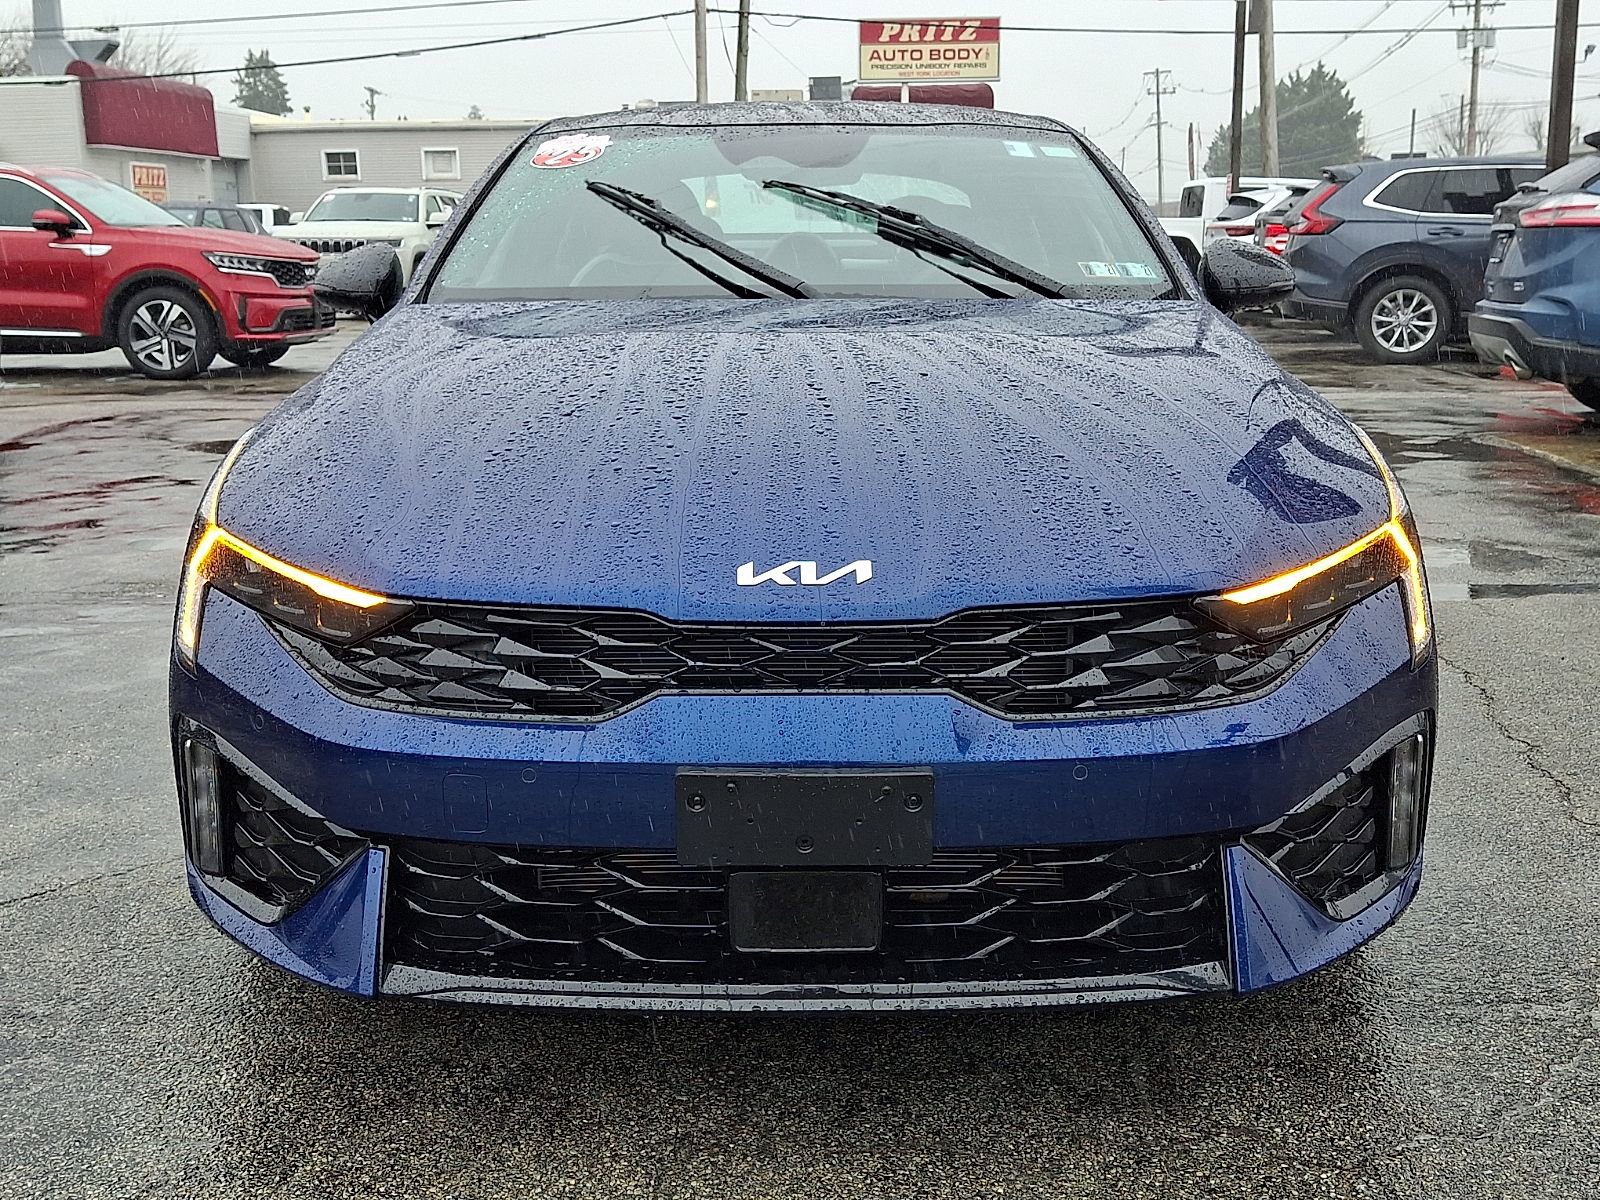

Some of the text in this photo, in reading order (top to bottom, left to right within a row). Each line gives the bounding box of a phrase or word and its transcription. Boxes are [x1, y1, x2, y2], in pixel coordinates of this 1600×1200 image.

[878, 20, 981, 42] PRITZ
[869, 48, 983, 61] AUTO BODY
[736, 560, 873, 586] KIA
